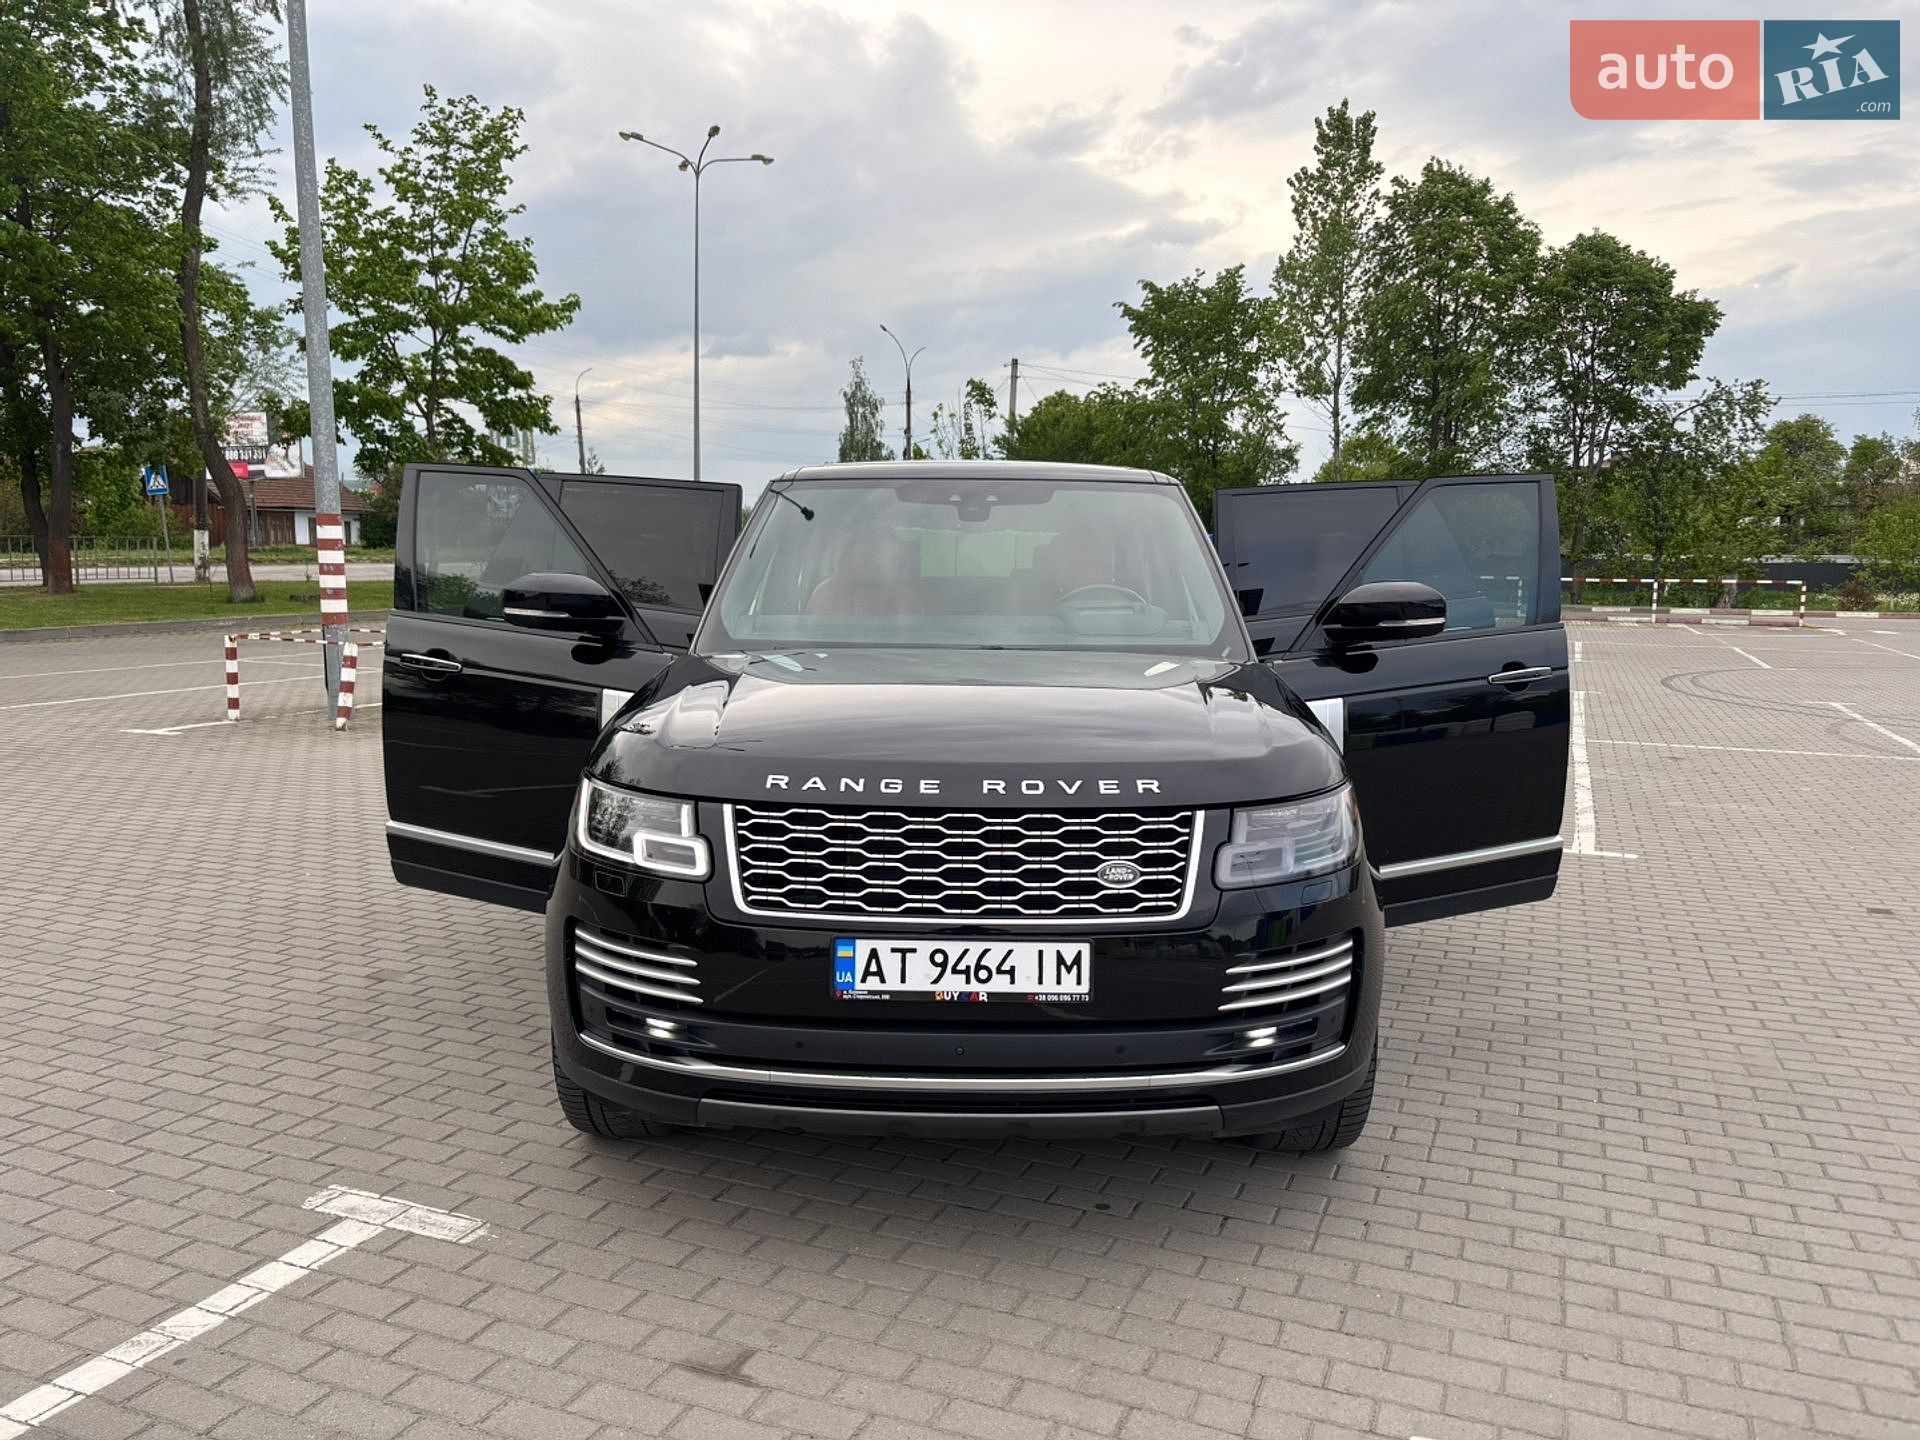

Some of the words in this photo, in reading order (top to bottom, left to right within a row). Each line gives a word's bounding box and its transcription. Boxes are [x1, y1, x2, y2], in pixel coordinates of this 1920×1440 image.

[766, 774, 940, 794] RANGE
[982, 779, 1161, 795] ROVER
[836, 971, 853, 983] UA
[860, 947, 917, 984] AT
[929, 948, 1016, 985] 9464
[1038, 949, 1082, 986] IM
